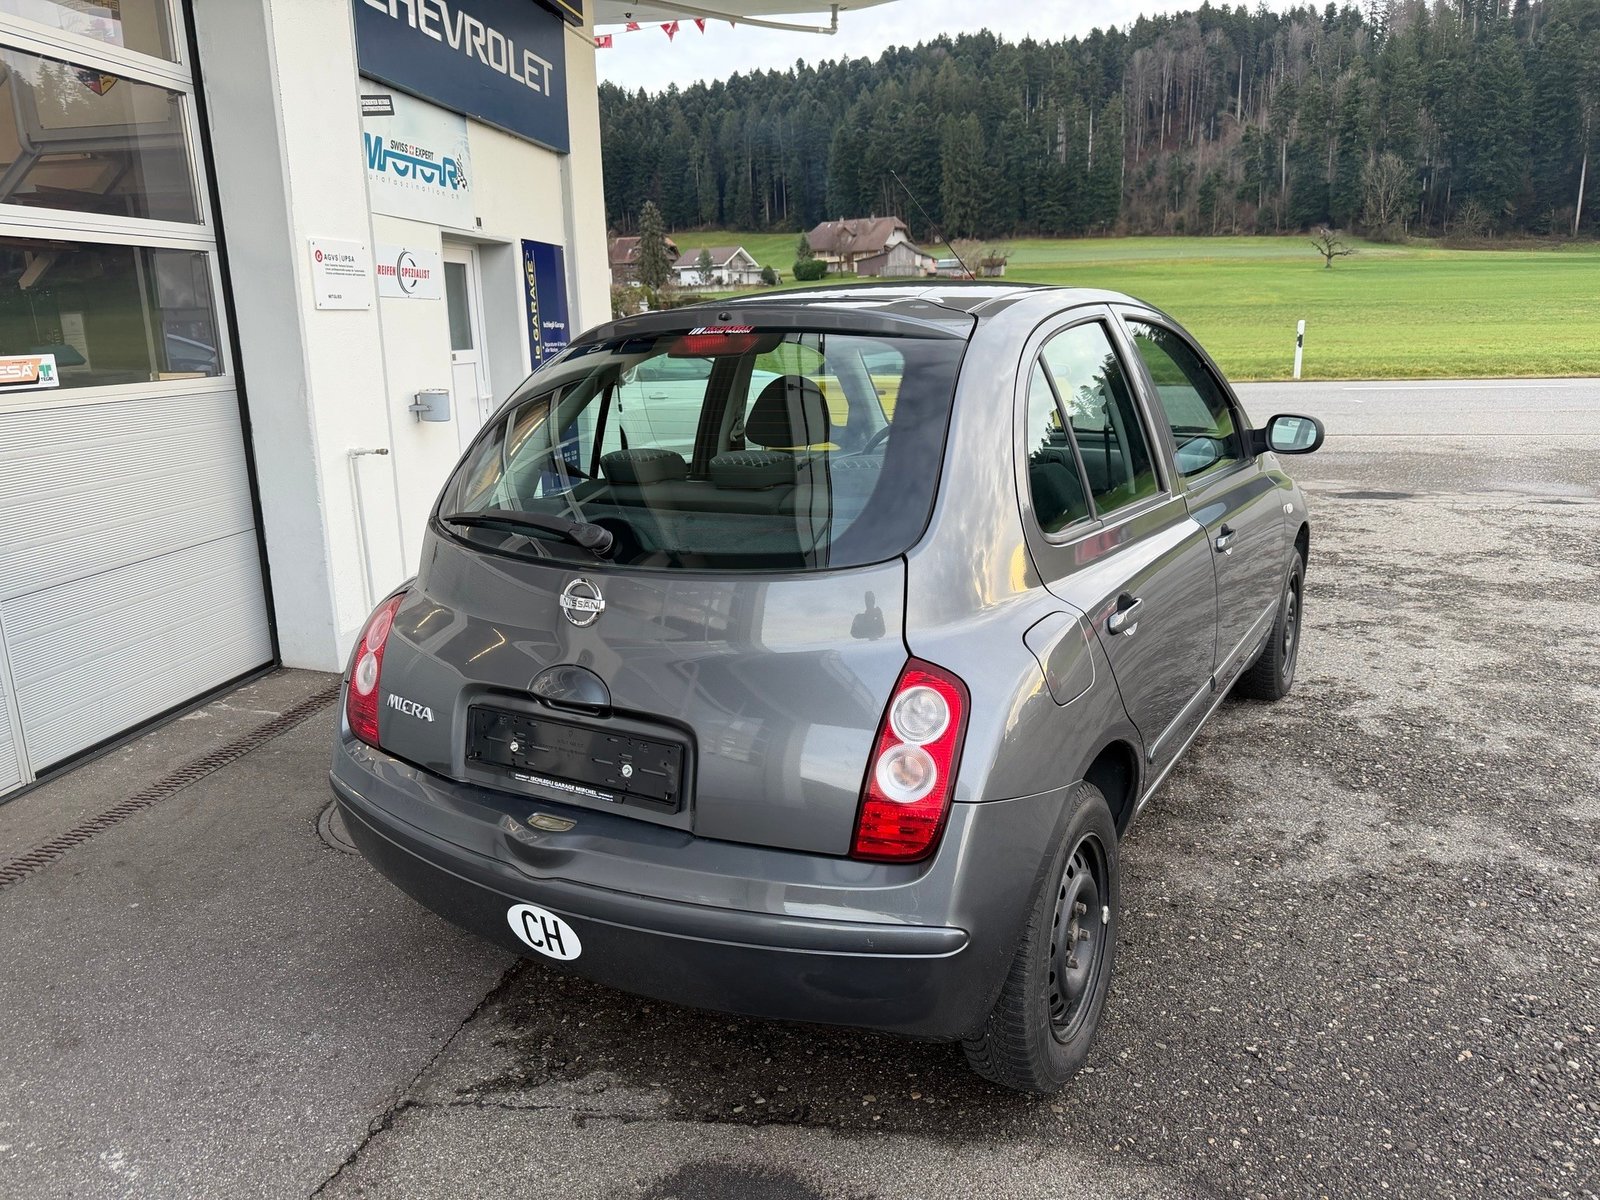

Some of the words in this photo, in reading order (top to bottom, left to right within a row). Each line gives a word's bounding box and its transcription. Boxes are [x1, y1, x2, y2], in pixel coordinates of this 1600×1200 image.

[364, 132, 458, 191] MOTOR
[390, 139, 409, 154] SWISS
[415, 147, 434, 161] EXPERT
[377, 264, 397, 277] REIFEN
[401, 266, 430, 280] SPEZIALIST
[527, 260, 540, 342] GARAGE
[563, 597, 600, 610] NISSAN
[387, 693, 435, 722] MICRA
[521, 910, 567, 956] CH
